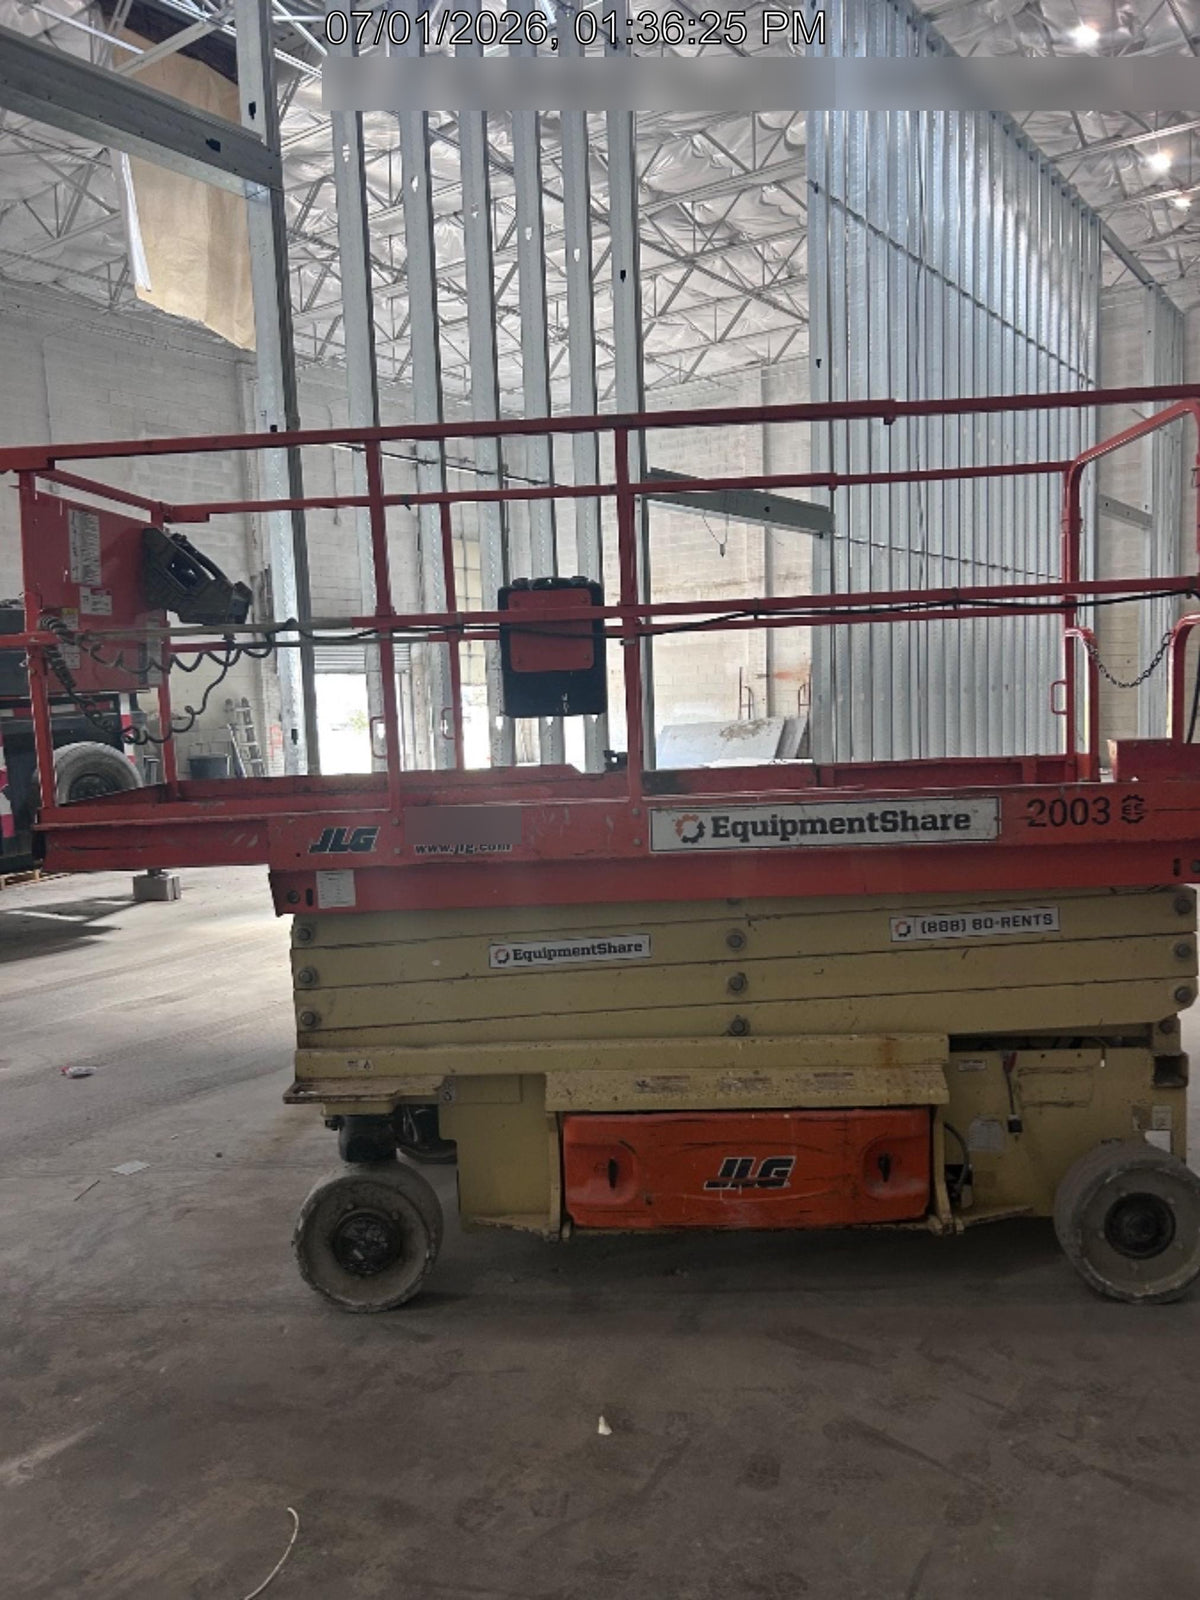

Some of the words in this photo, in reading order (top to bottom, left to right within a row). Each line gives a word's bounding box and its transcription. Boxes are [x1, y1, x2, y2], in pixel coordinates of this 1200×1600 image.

[711, 809, 971, 841] EquipmentShare
[1026, 796, 1111, 827] 2003
[308, 826, 381, 854] JLG
[512, 941, 643, 962] EquipmentShare
[704, 1155, 796, 1190] JLG
